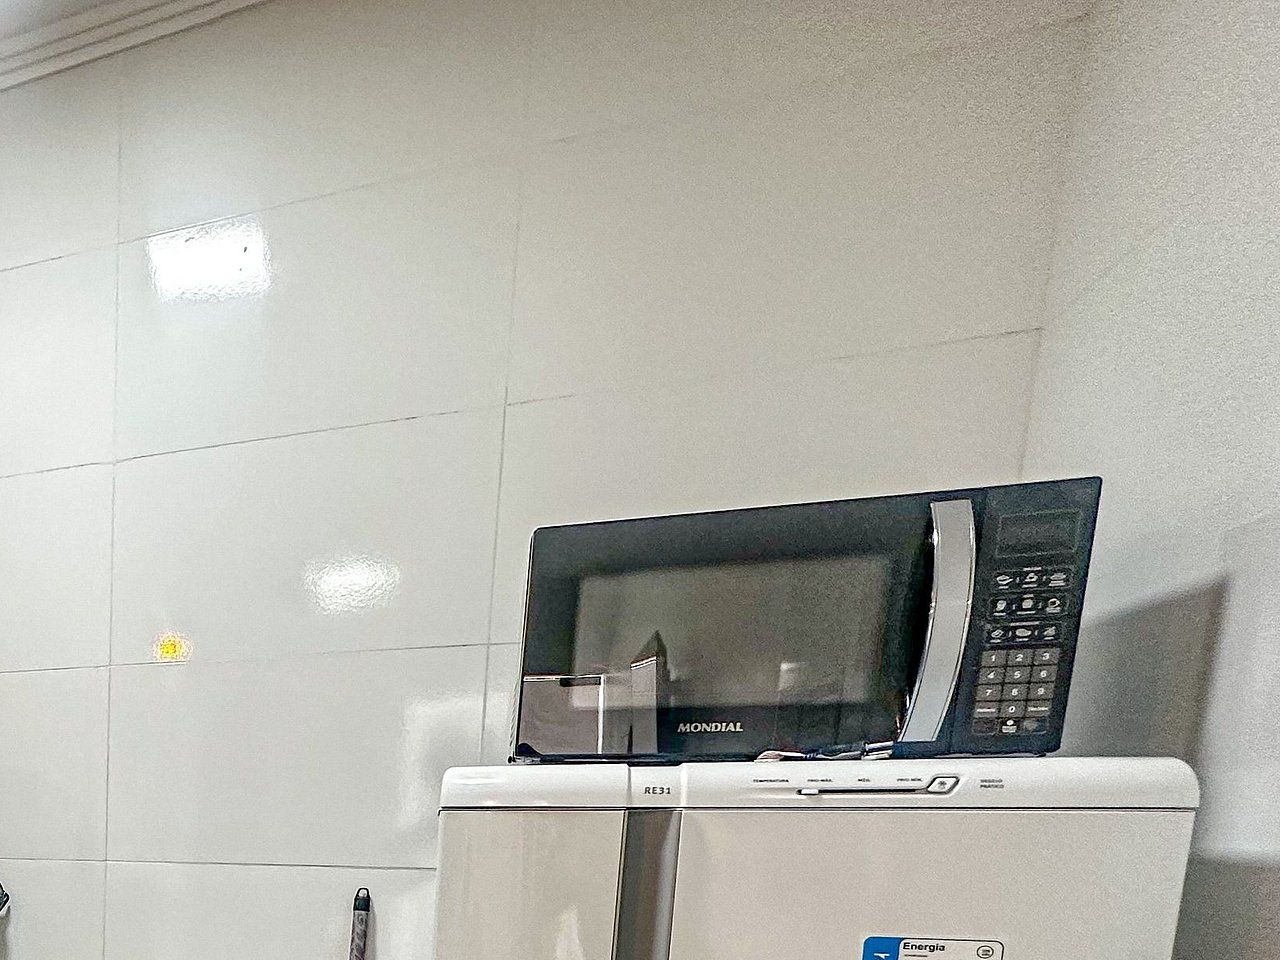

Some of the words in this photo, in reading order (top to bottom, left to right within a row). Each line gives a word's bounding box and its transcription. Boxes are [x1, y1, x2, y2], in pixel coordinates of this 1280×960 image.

[1015, 653, 1024, 662] 2
[1042, 652, 1050, 660] 3
[987, 670, 996, 679] 4
[1013, 670, 1021, 679] 5
[1040, 670, 1048, 678] 6
[985, 689, 993, 697] 7
[1037, 687, 1045, 695] 9
[677, 721, 744, 733] MONDIAL
[644, 786, 671, 795] RE31
[902, 942, 946, 953] Energia
